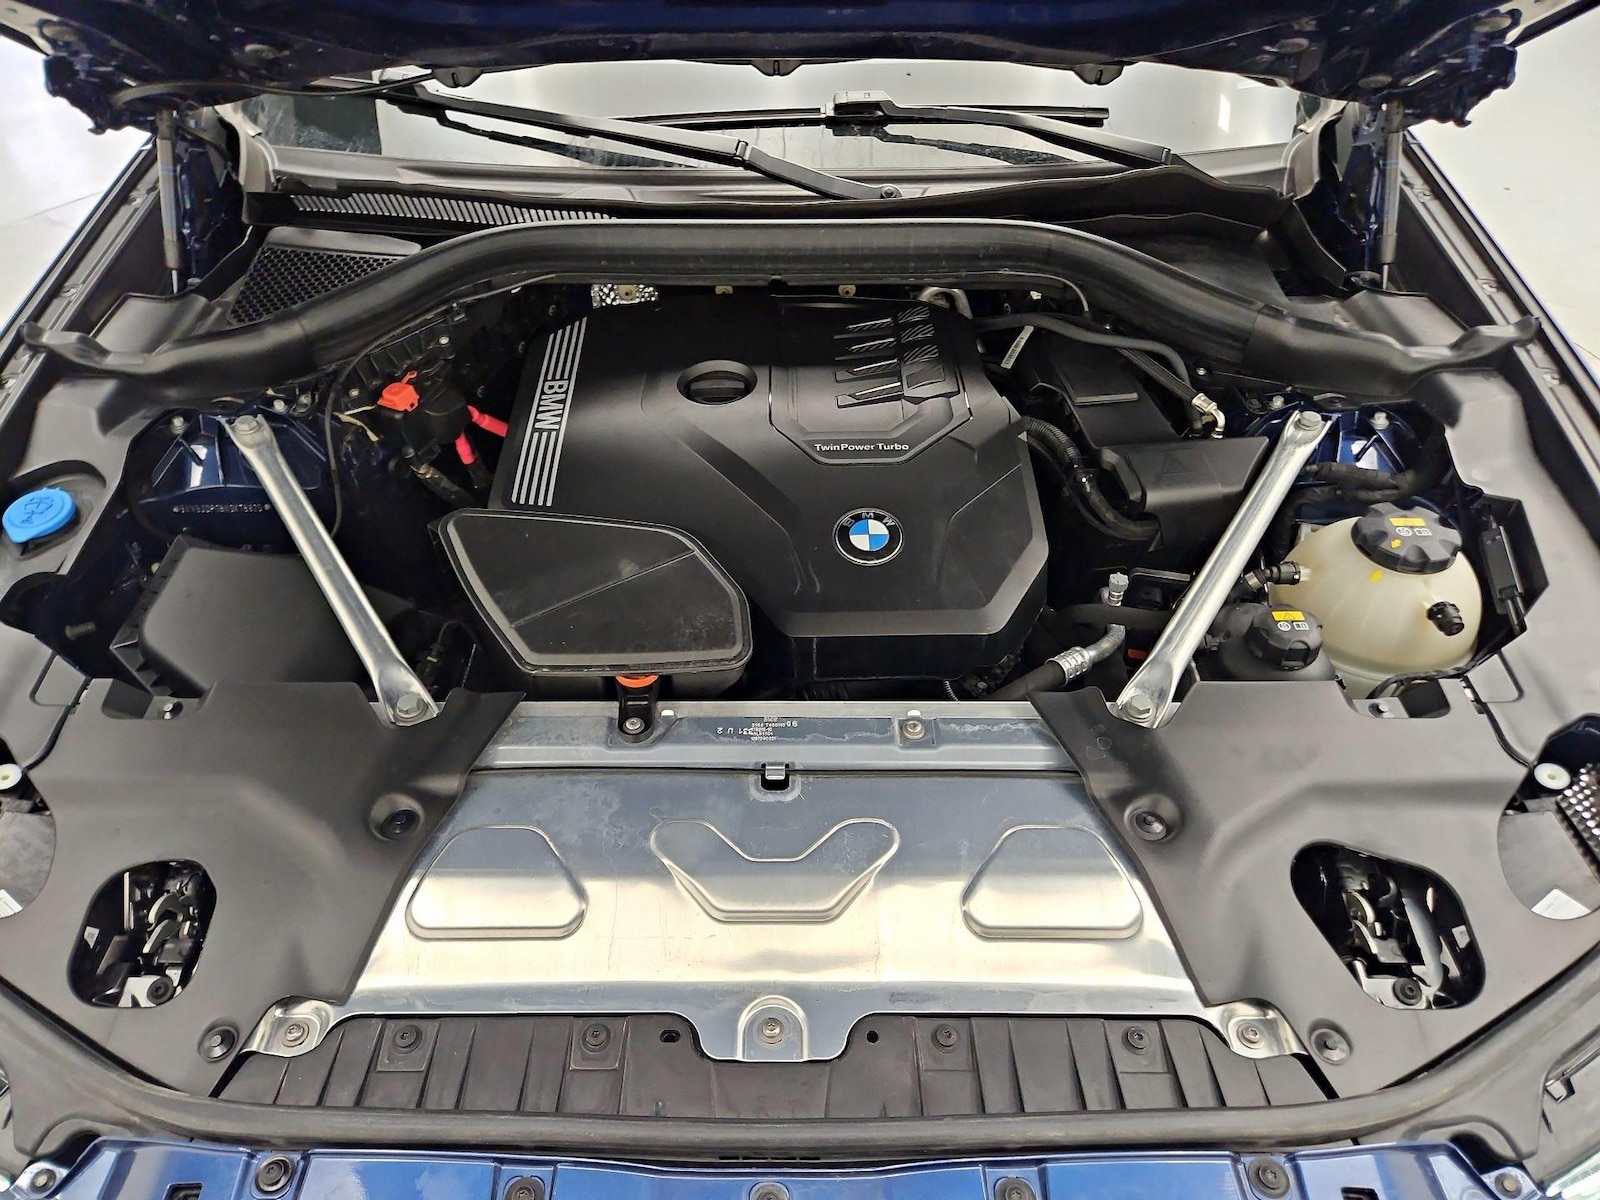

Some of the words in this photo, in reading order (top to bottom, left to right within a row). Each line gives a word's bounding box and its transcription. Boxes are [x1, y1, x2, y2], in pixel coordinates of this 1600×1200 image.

[534, 379, 569, 430] BMW
[814, 443, 875, 452] TwinPower
[876, 442, 909, 451] Turbo
[843, 512, 896, 527] BMW
